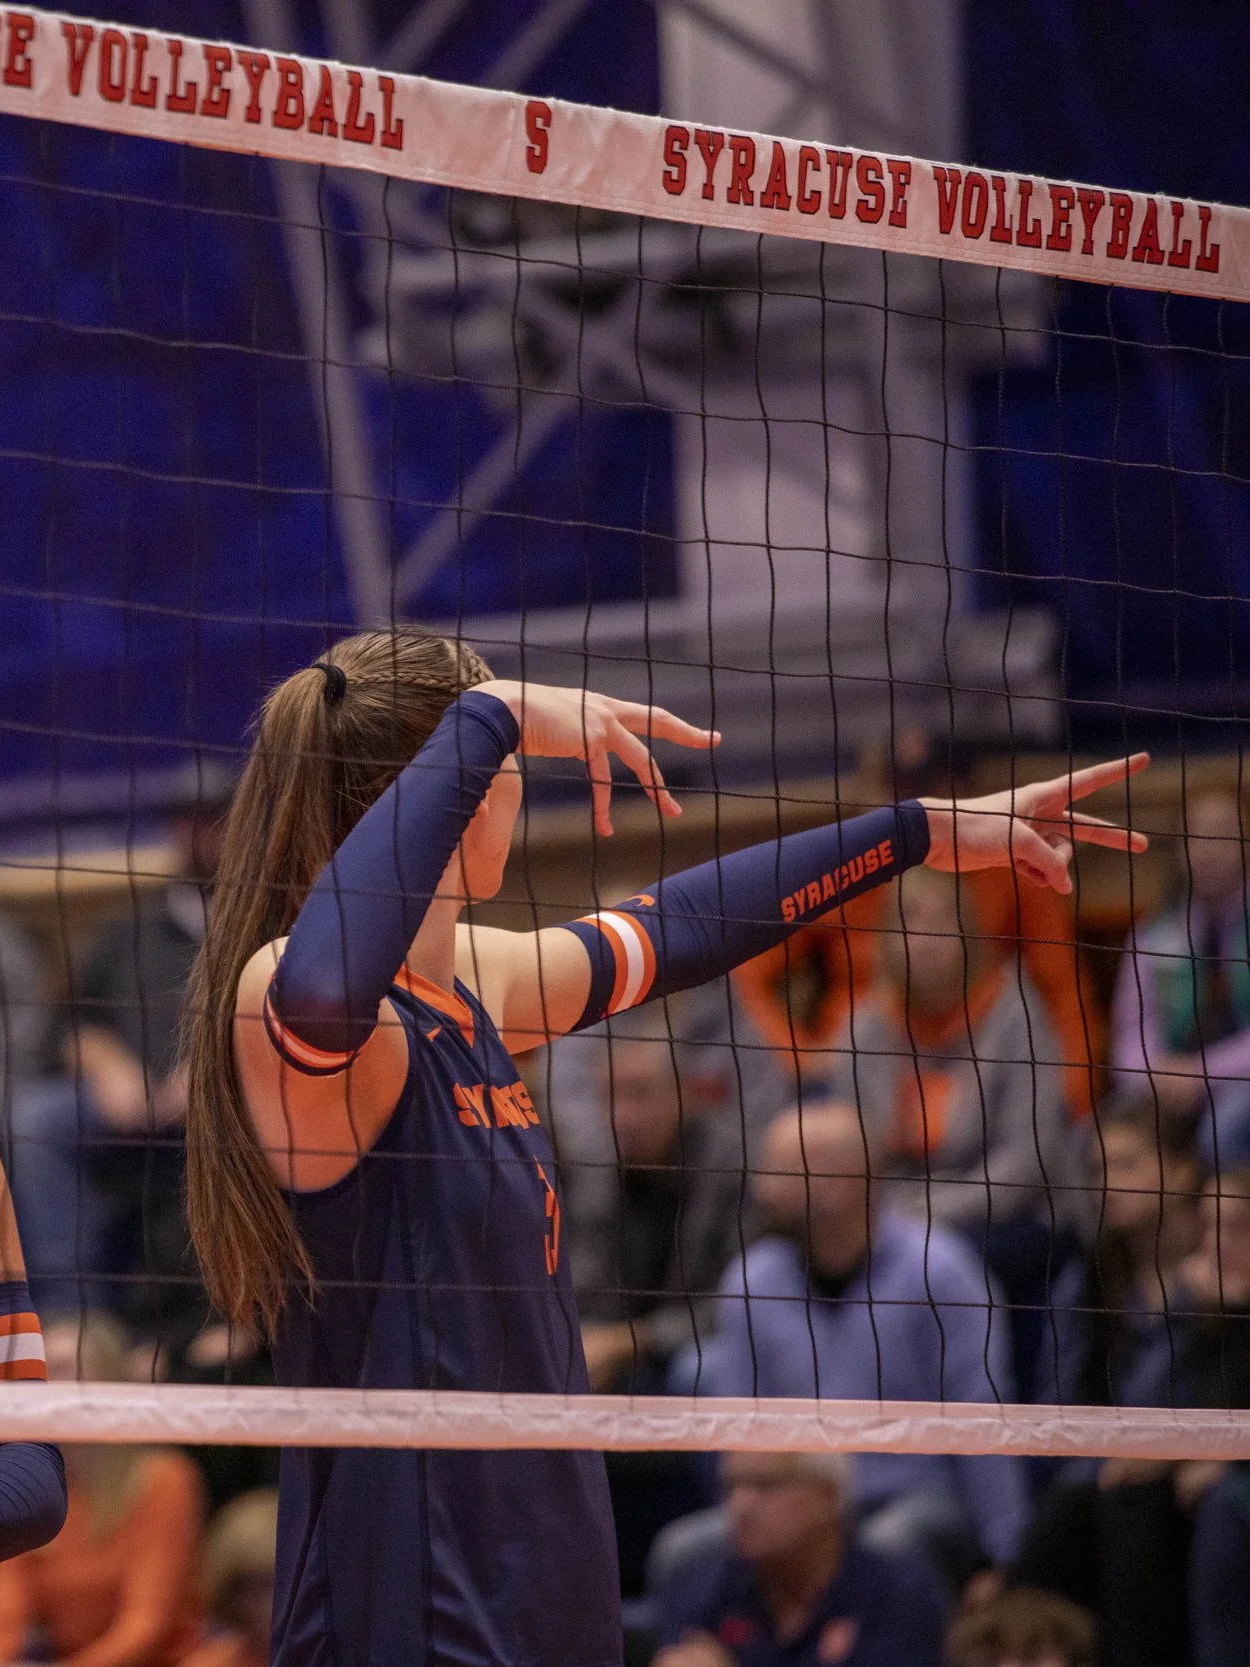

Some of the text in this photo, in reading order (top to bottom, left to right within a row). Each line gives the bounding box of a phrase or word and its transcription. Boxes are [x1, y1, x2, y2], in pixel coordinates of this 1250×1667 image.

[61, 23, 403, 150] VOLLEYBALL
[525, 101, 551, 173] S
[662, 126, 1220, 273] SYRACUSE VOLLEYBALL
[781, 840, 894, 923] SYRACUSE
